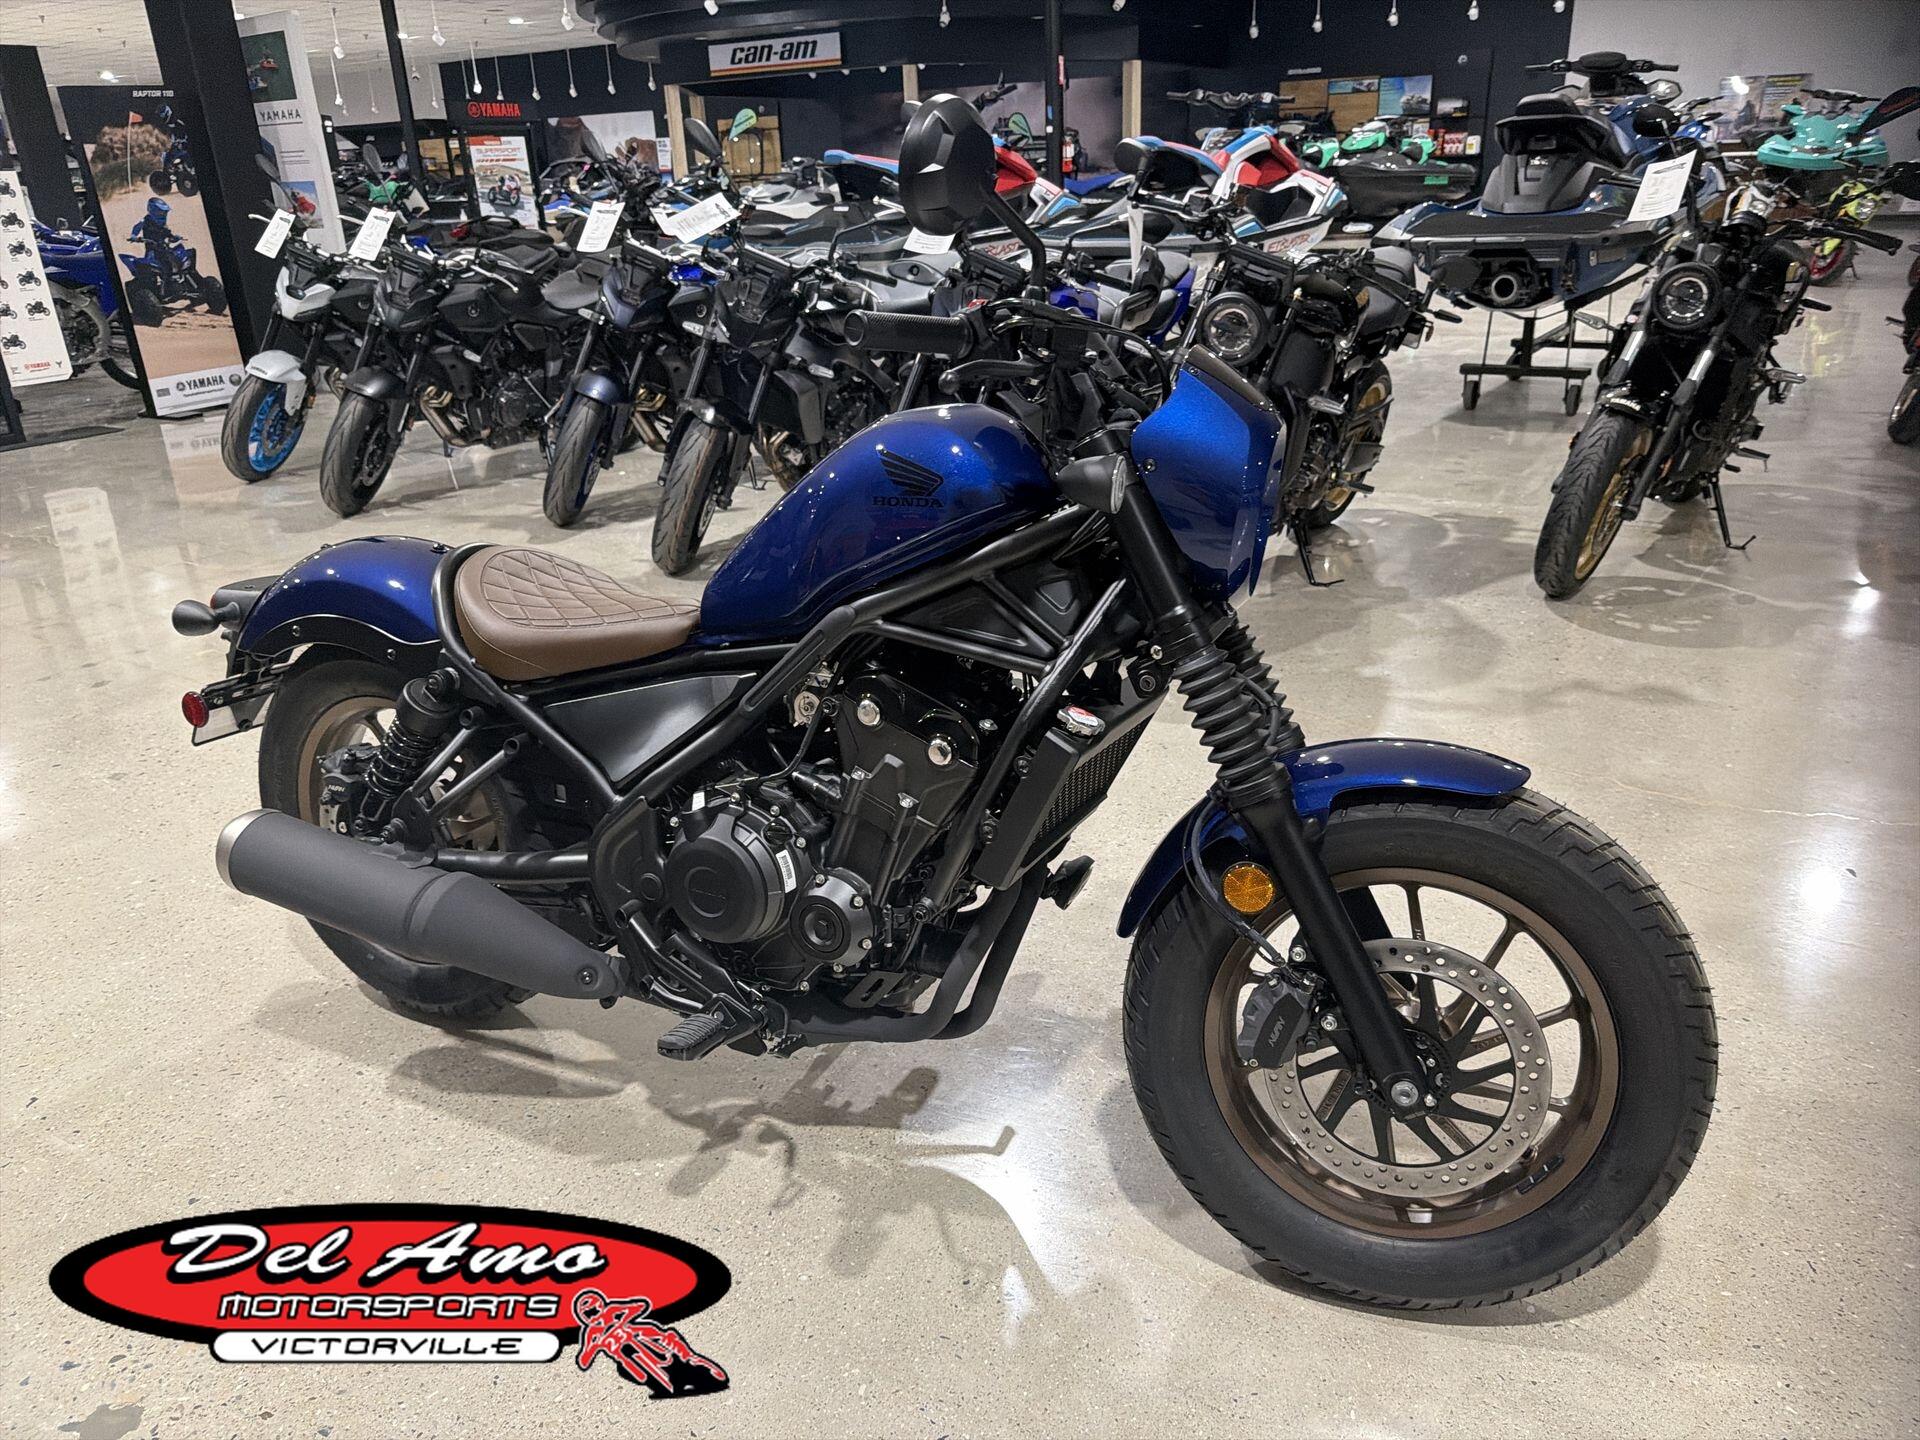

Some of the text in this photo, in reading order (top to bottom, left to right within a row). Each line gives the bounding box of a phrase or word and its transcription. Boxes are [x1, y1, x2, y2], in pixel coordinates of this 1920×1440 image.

[730, 40, 818, 66] can-am
[132, 90, 161, 98] RAPTOR
[260, 109, 302, 122] YAMAHA
[480, 102, 521, 117] YAMAHA
[186, 374, 226, 390] YAMAHA
[872, 496, 945, 508] HONDA
